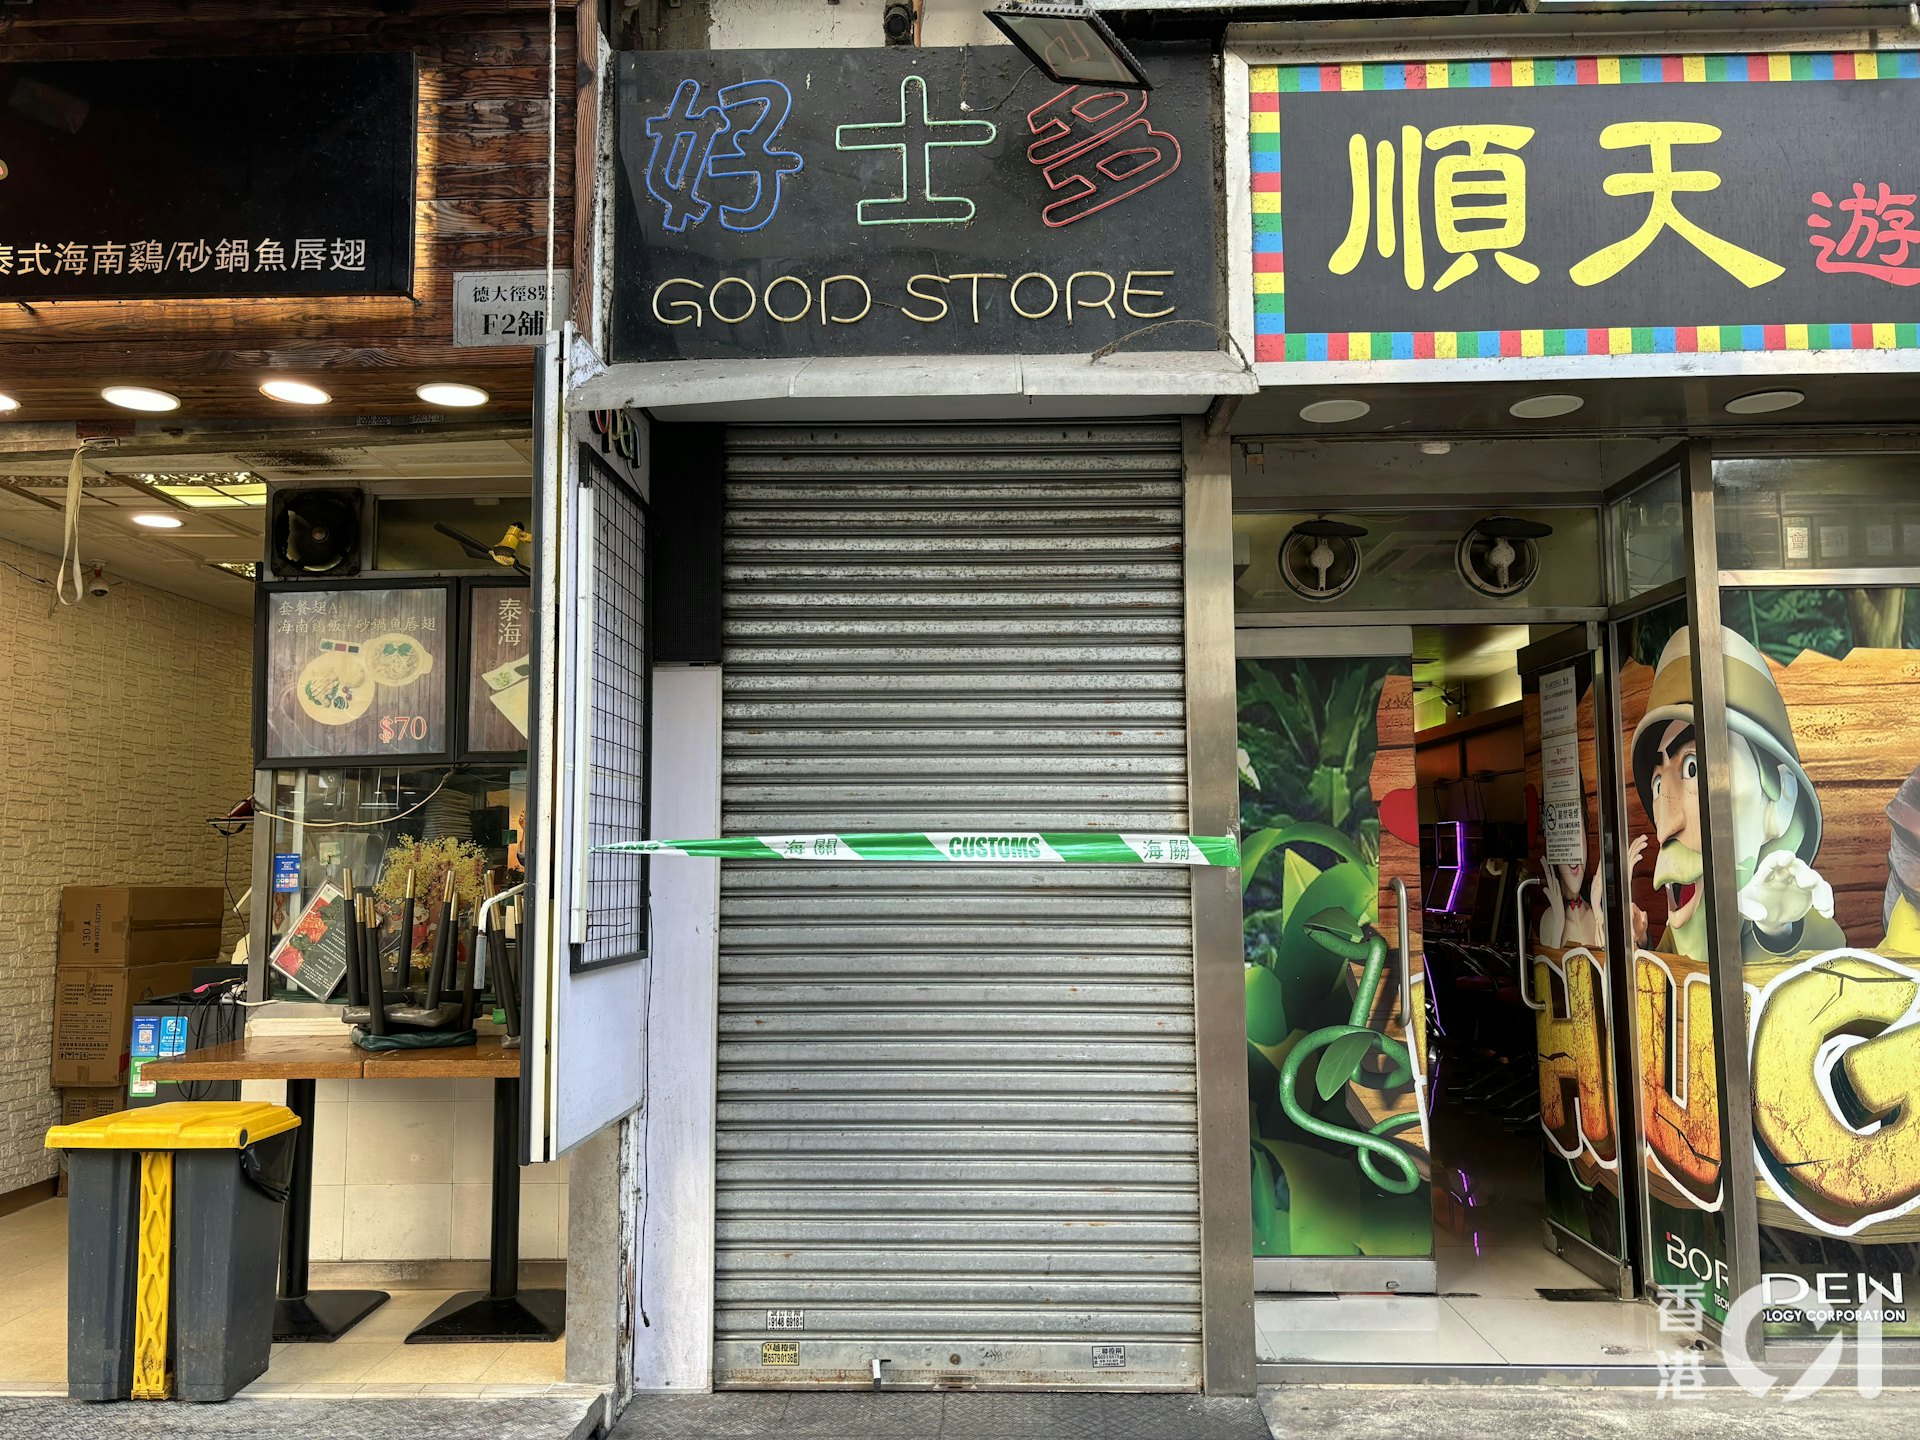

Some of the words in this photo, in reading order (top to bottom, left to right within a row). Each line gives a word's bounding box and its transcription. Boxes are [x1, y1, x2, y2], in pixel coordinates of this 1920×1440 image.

[646, 76, 1182, 232] 好士多
[1328, 121, 1786, 291] 順天
[1807, 182, 1920, 286] 遊
[652, 274, 872, 328] GOOD
[901, 270, 1175, 326] STORE
[379, 715, 428, 744] $70
[784, 838, 837, 855] 海關
[949, 837, 1040, 858] CUSTOMS
[1143, 839, 1190, 860] 海關
[1806, 1309, 1906, 1322] CORPORATION
